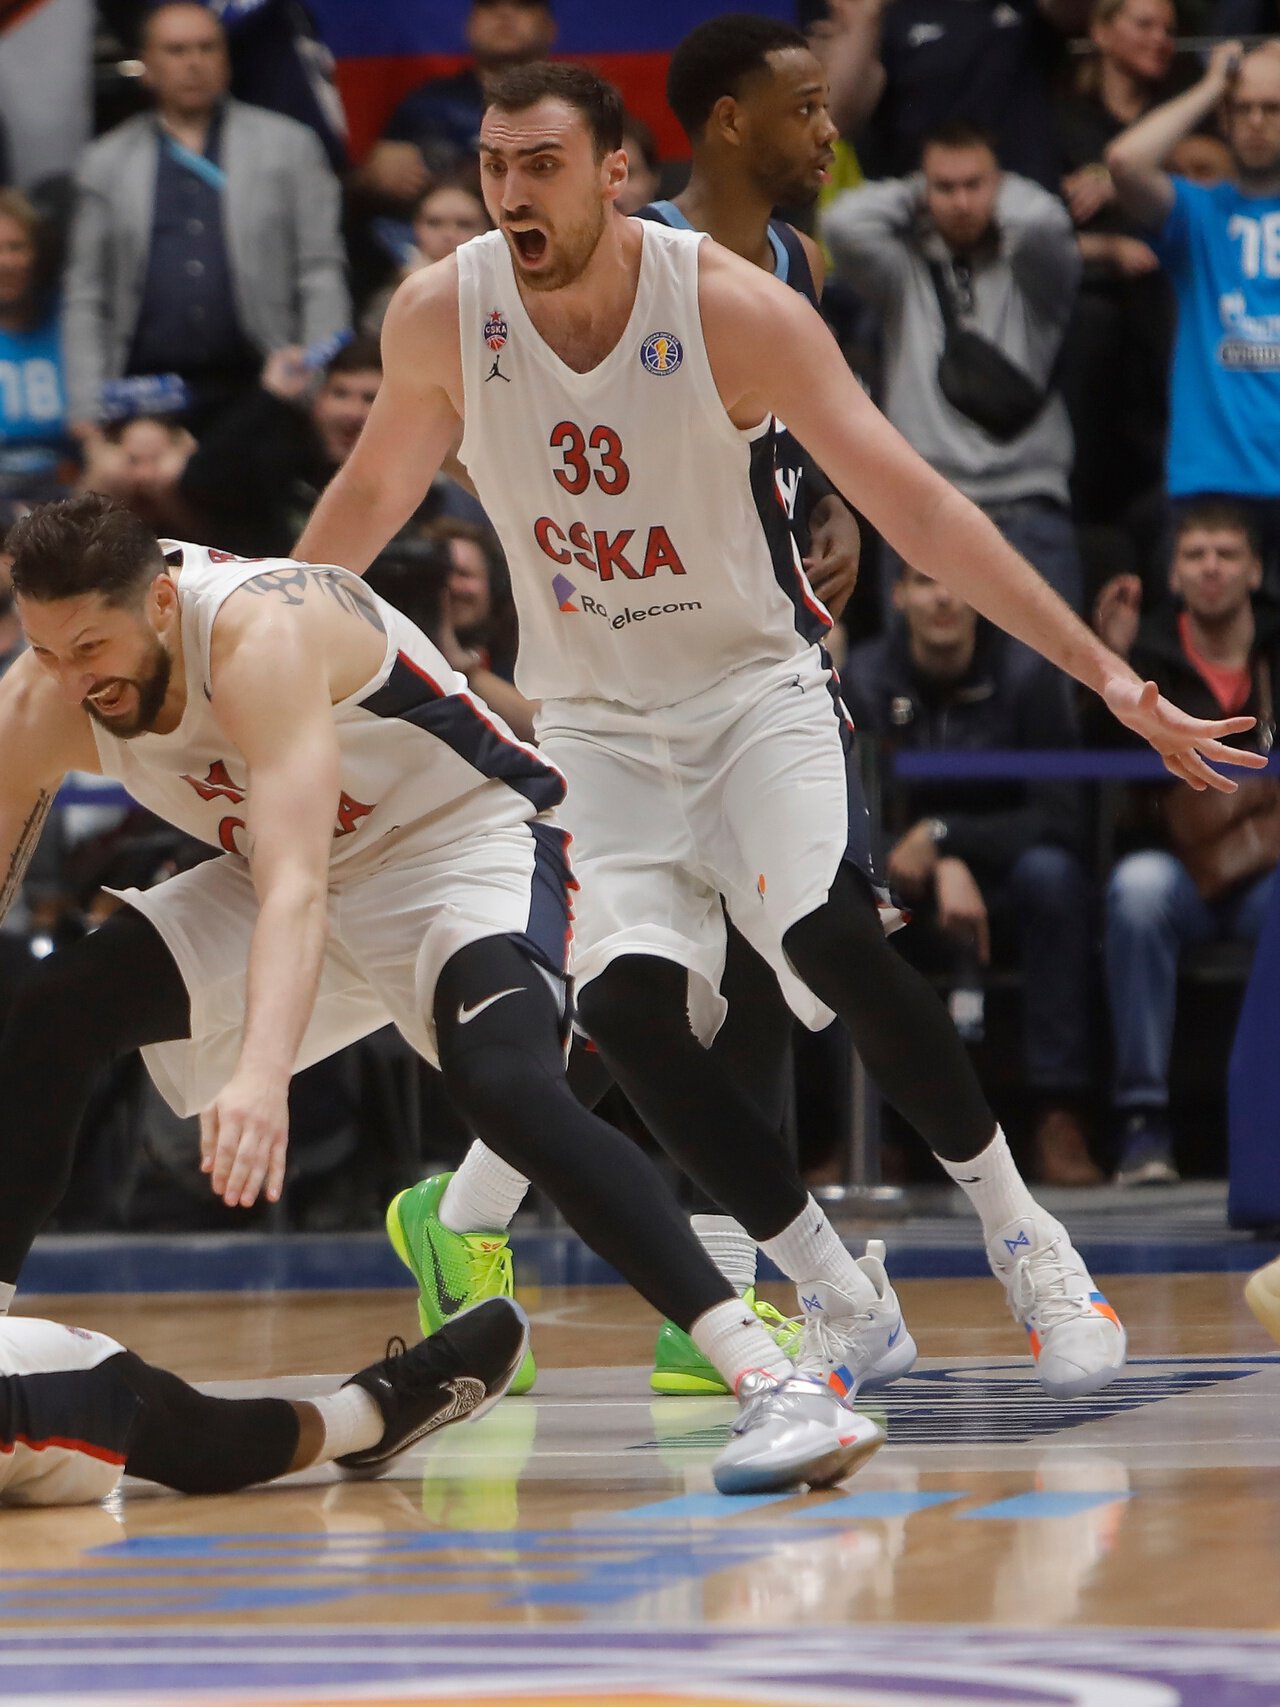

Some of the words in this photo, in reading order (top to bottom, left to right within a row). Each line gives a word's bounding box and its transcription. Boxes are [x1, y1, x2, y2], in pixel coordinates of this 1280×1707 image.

[485, 324, 507, 335] CSKA
[550, 420, 630, 496] 33
[534, 516, 687, 581] CSKA
[581, 595, 702, 631] Roelecom
